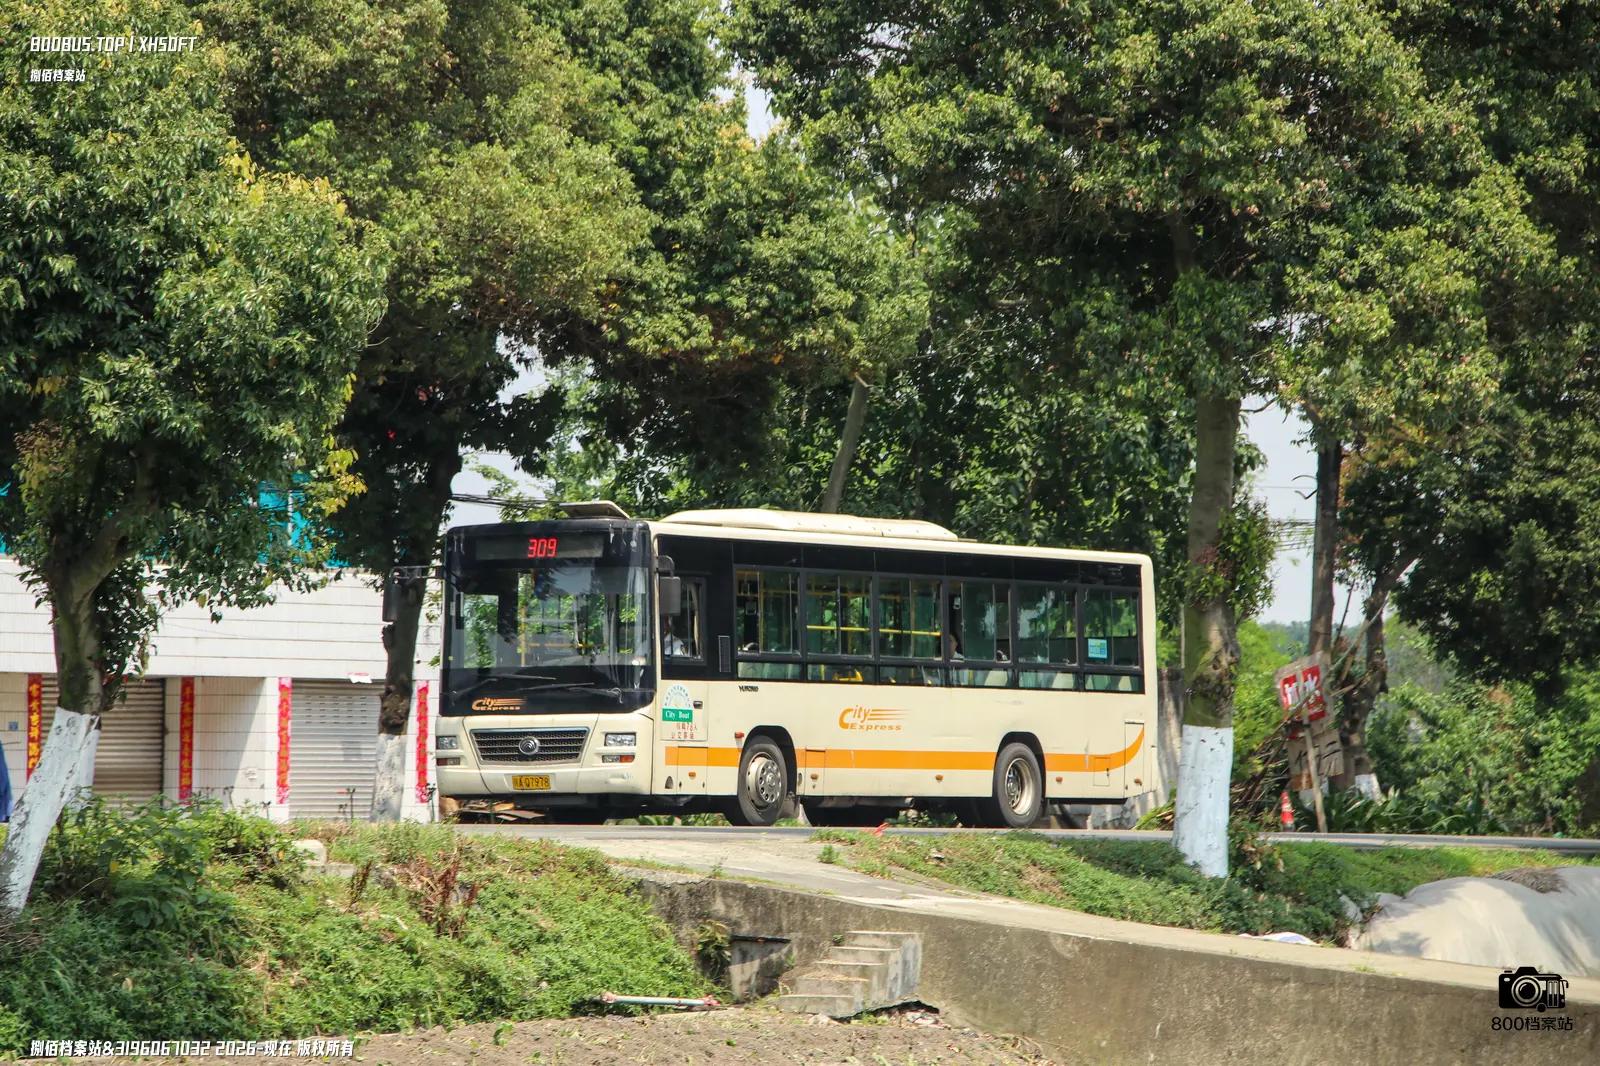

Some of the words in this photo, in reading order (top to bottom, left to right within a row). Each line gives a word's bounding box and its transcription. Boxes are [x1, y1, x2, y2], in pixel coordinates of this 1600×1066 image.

[527, 538, 557, 558] 309
[665, 710, 676, 720] City
[839, 704, 870, 729] City
[850, 722, 902, 731] Express
